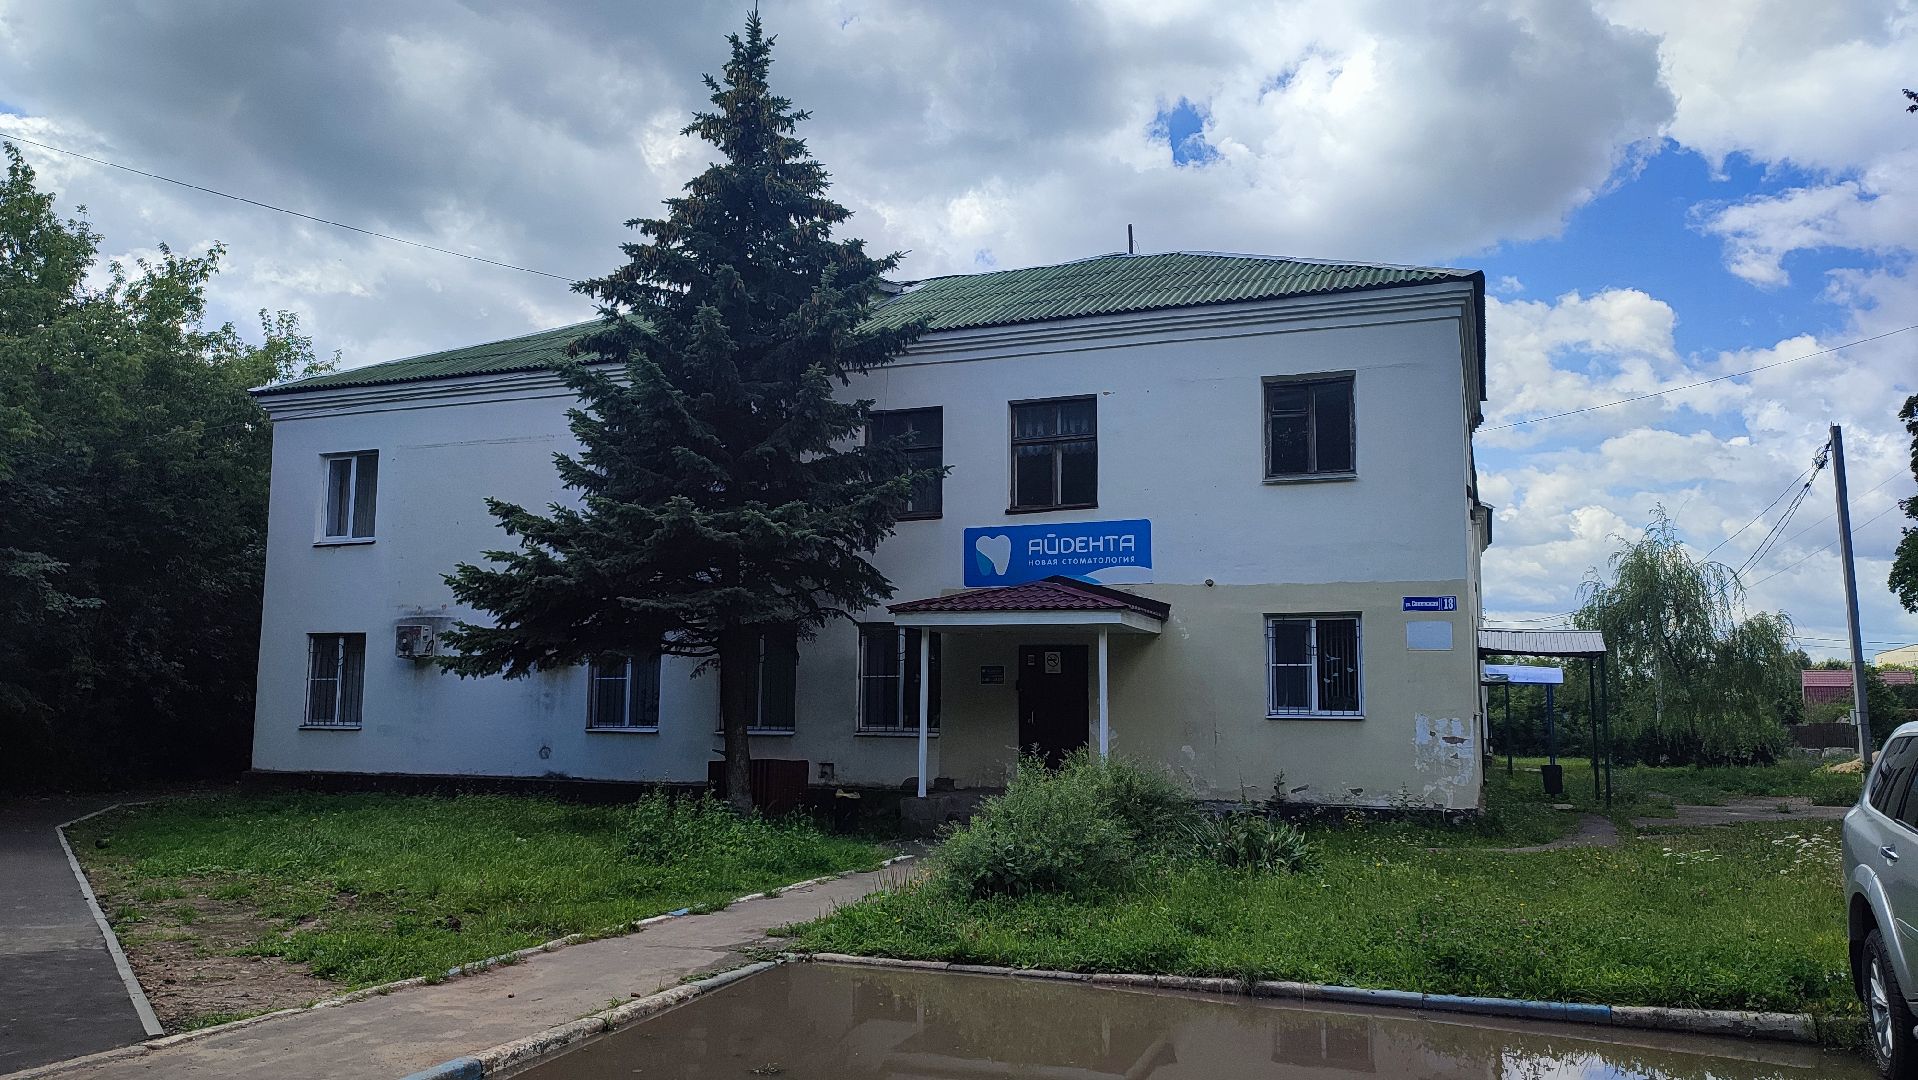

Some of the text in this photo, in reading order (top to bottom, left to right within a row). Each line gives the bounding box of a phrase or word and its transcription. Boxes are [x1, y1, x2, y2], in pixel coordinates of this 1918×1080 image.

[1028, 556, 1135, 566] НОВАЯ СТОМАТОЛОГИЯ
[1444, 598, 1453, 609] 18
